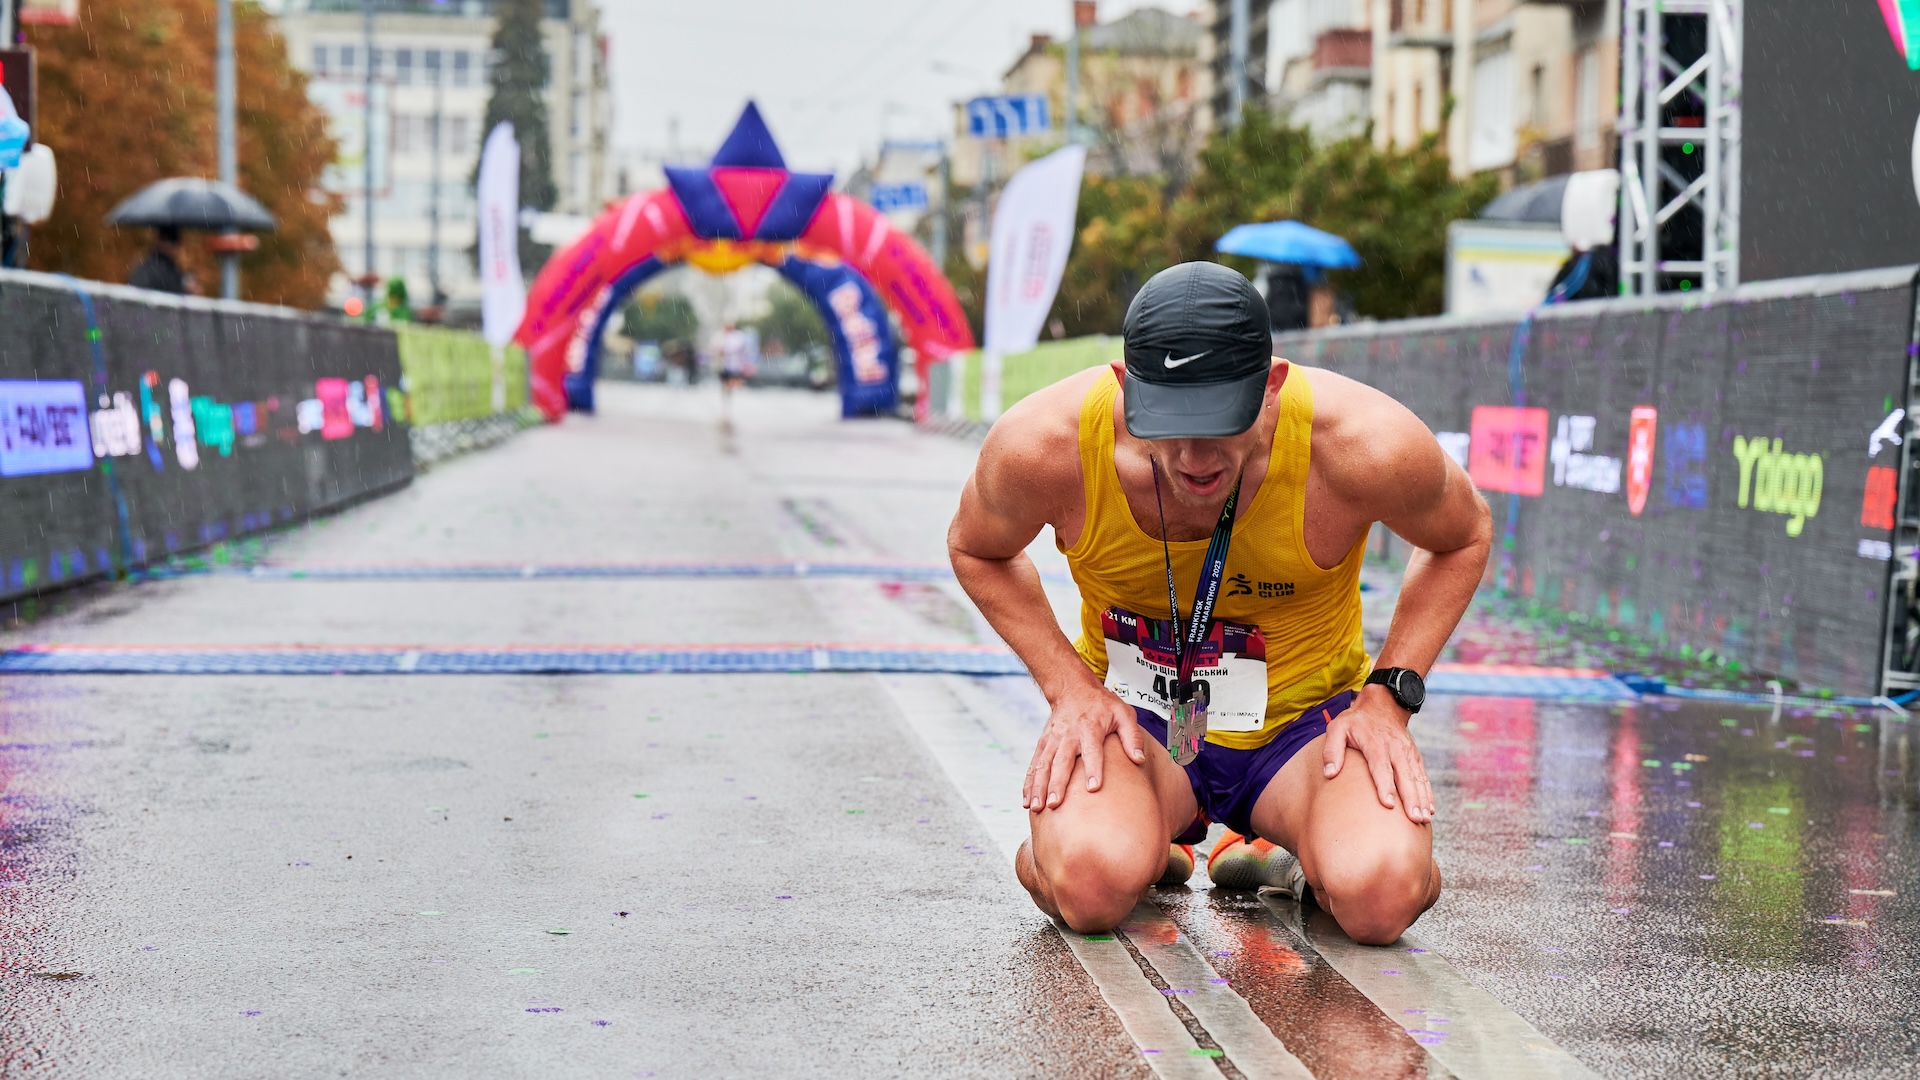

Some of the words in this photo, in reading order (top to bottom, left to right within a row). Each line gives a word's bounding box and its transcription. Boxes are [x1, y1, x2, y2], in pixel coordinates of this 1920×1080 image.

[1258, 581, 1294, 590] IRON
[1196, 624, 1206, 642] HALF
[1201, 580, 1218, 622] MARATHON
[1212, 560, 1222, 578] 2023
[1258, 590, 1294, 598] CLUB
[1108, 612, 1118, 622] 21
[1121, 615, 1137, 627] KM
[1188, 600, 1204, 642] FRANKIVSK
[1136, 656, 1158, 672] Артур
[1158, 655, 1216, 665] FAET
